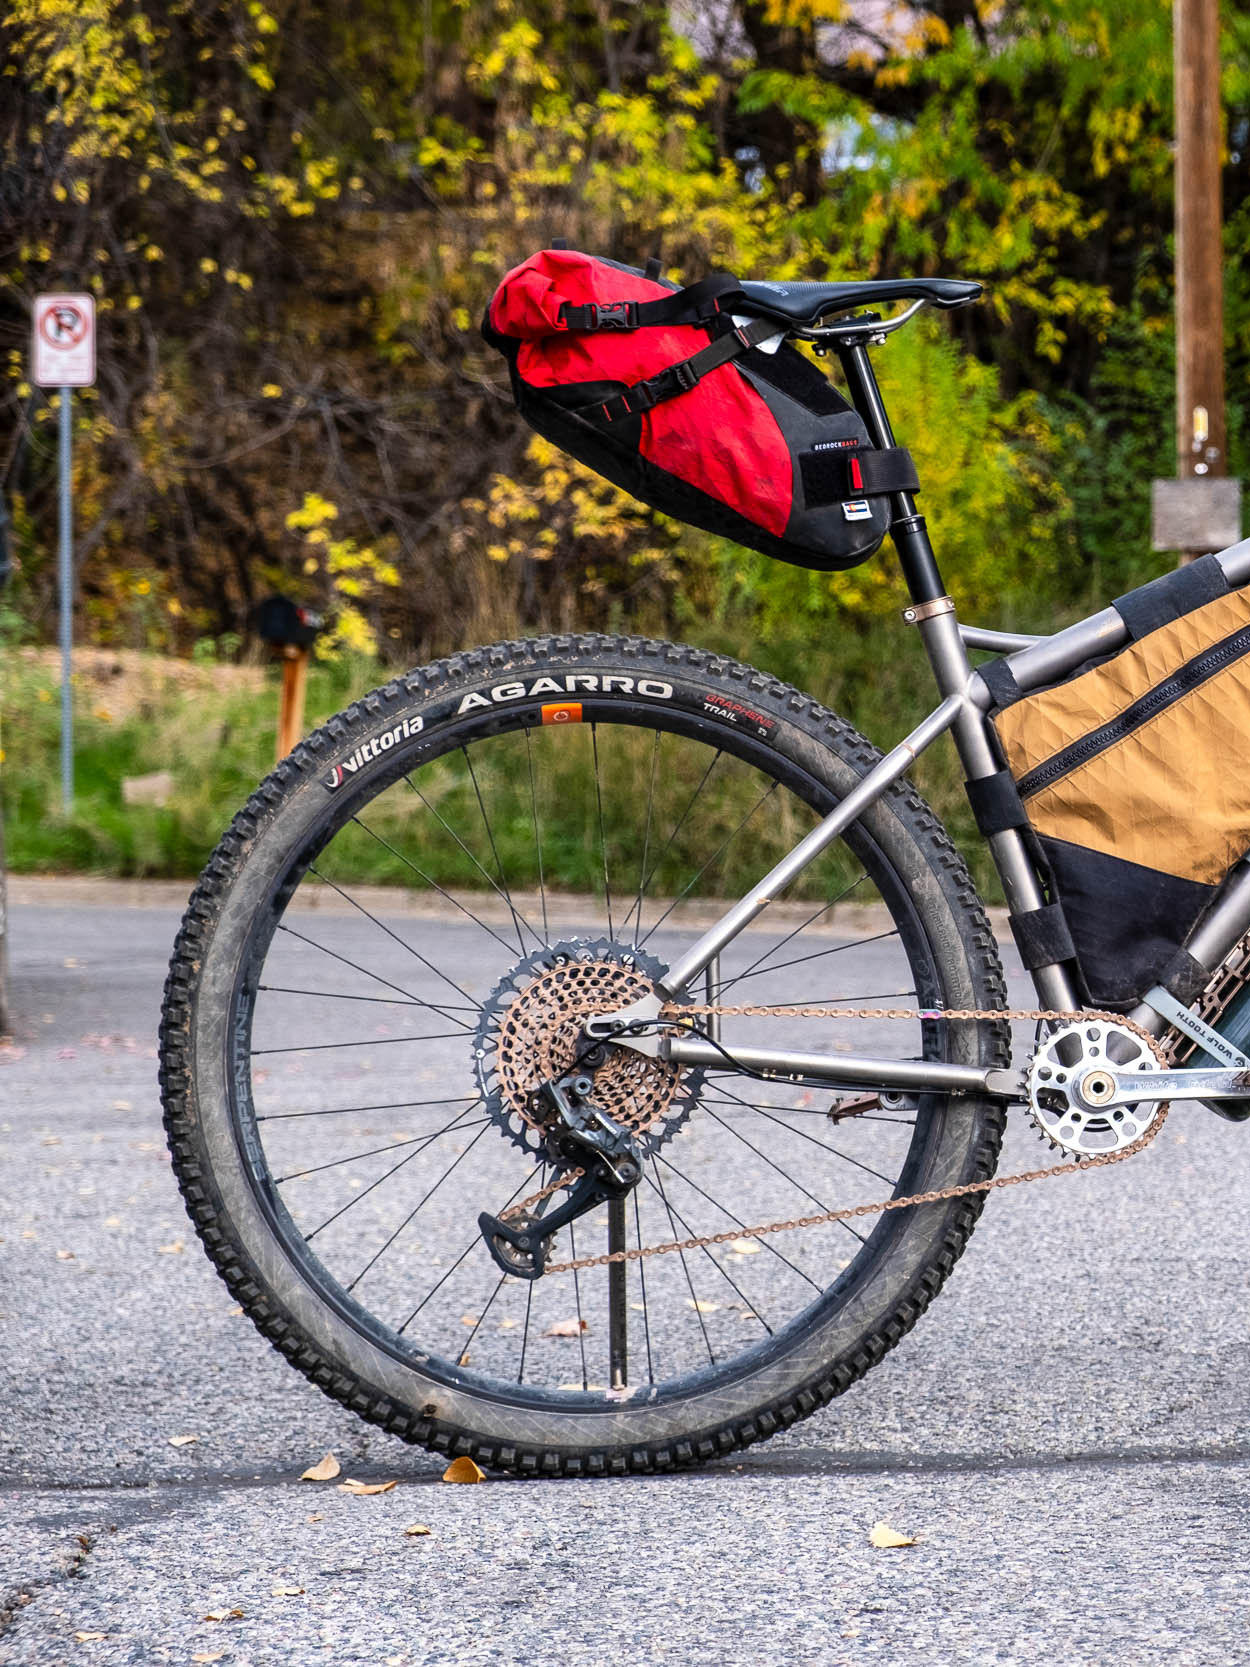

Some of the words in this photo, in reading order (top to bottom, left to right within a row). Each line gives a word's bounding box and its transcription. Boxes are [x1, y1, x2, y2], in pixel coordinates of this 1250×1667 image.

[457, 675, 674, 714] AGARRO
[705, 694, 776, 728] GRAPHENE
[703, 702, 738, 722] TRAIL
[342, 715, 424, 774] vittoria
[1176, 1011, 1207, 1037] TOOTH
[1207, 1034, 1233, 1059] WOLF
[233, 994, 266, 1181] SERPENTINE
